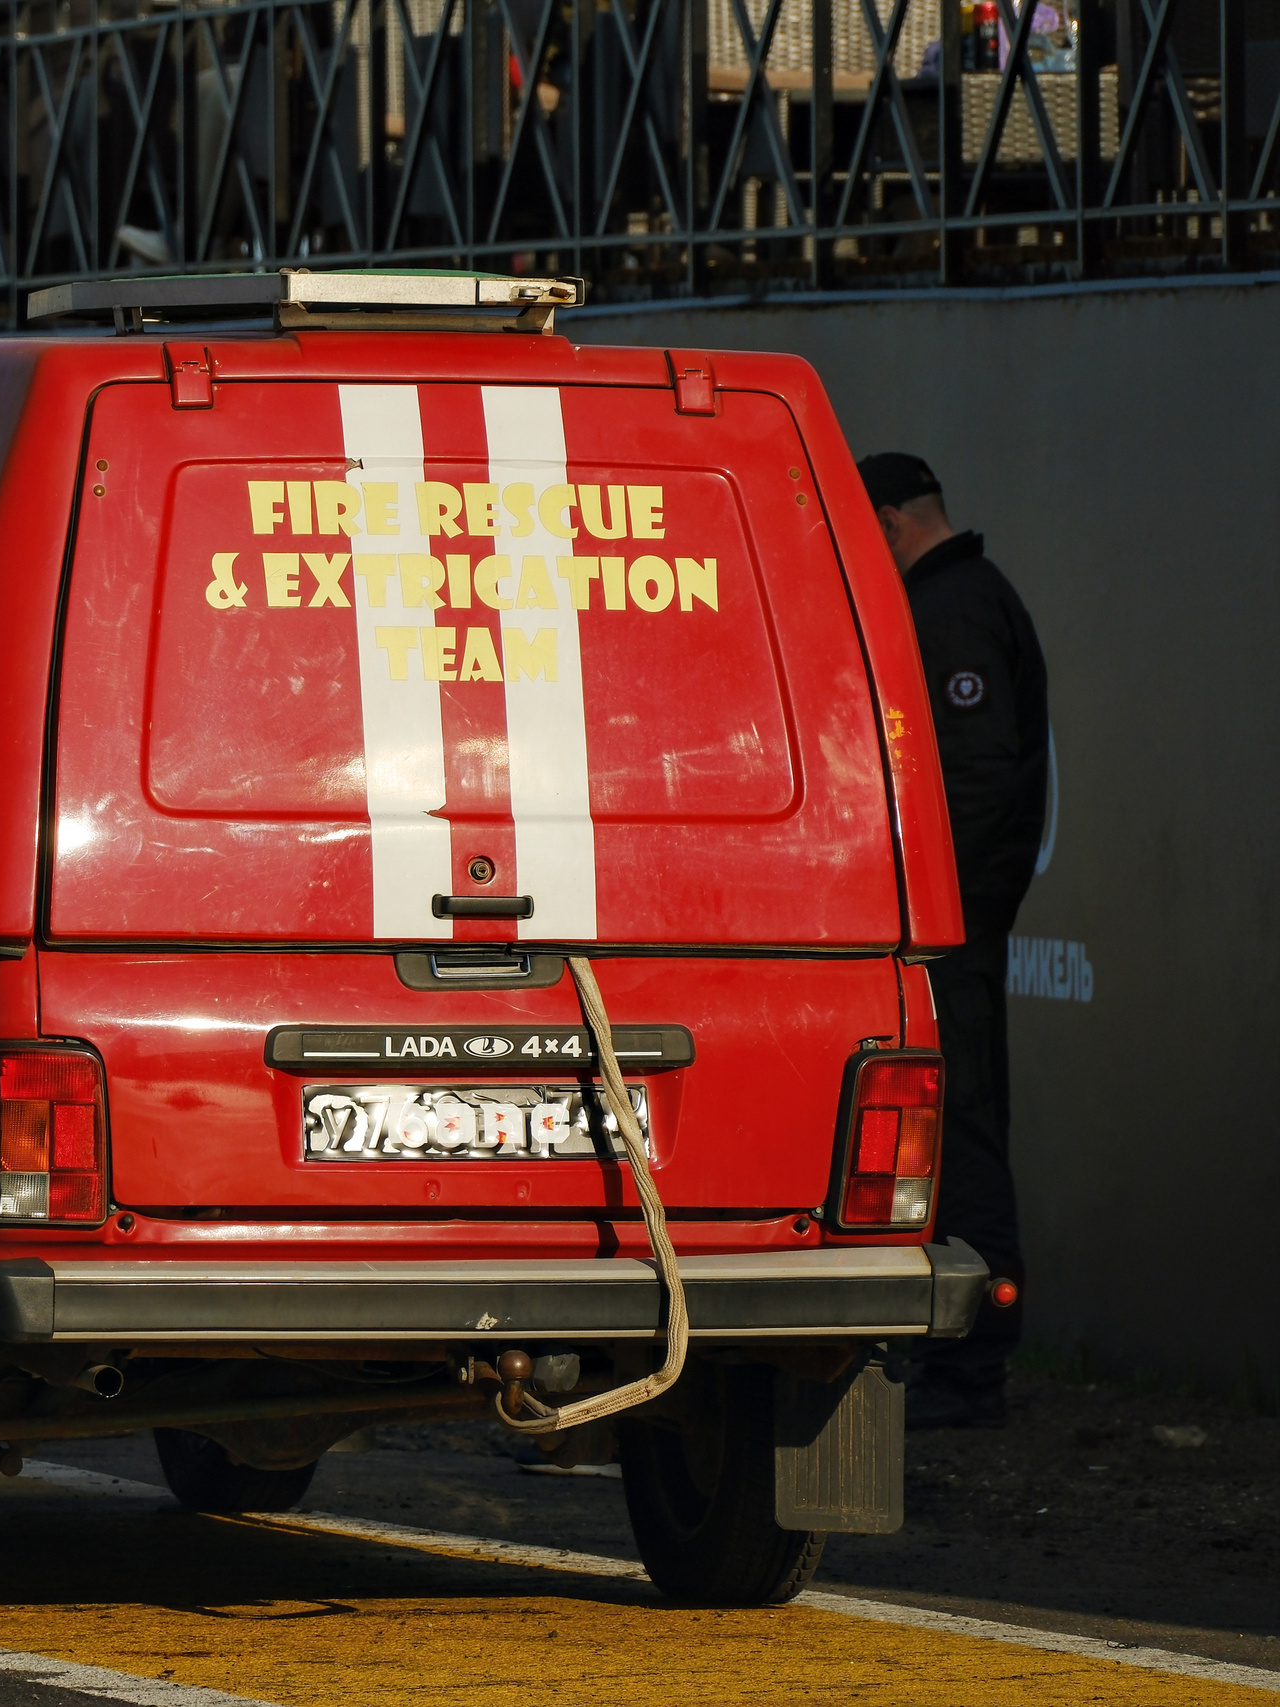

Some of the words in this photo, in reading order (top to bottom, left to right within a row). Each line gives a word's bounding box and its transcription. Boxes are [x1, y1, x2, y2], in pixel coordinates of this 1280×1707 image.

[246, 480, 402, 539] FIRE
[415, 481, 666, 540] RESCUE
[205, 552, 249, 610] &
[262, 552, 719, 612] EXTRICATION
[374, 625, 559, 682] TEAM
[385, 1036, 457, 1057] LADA
